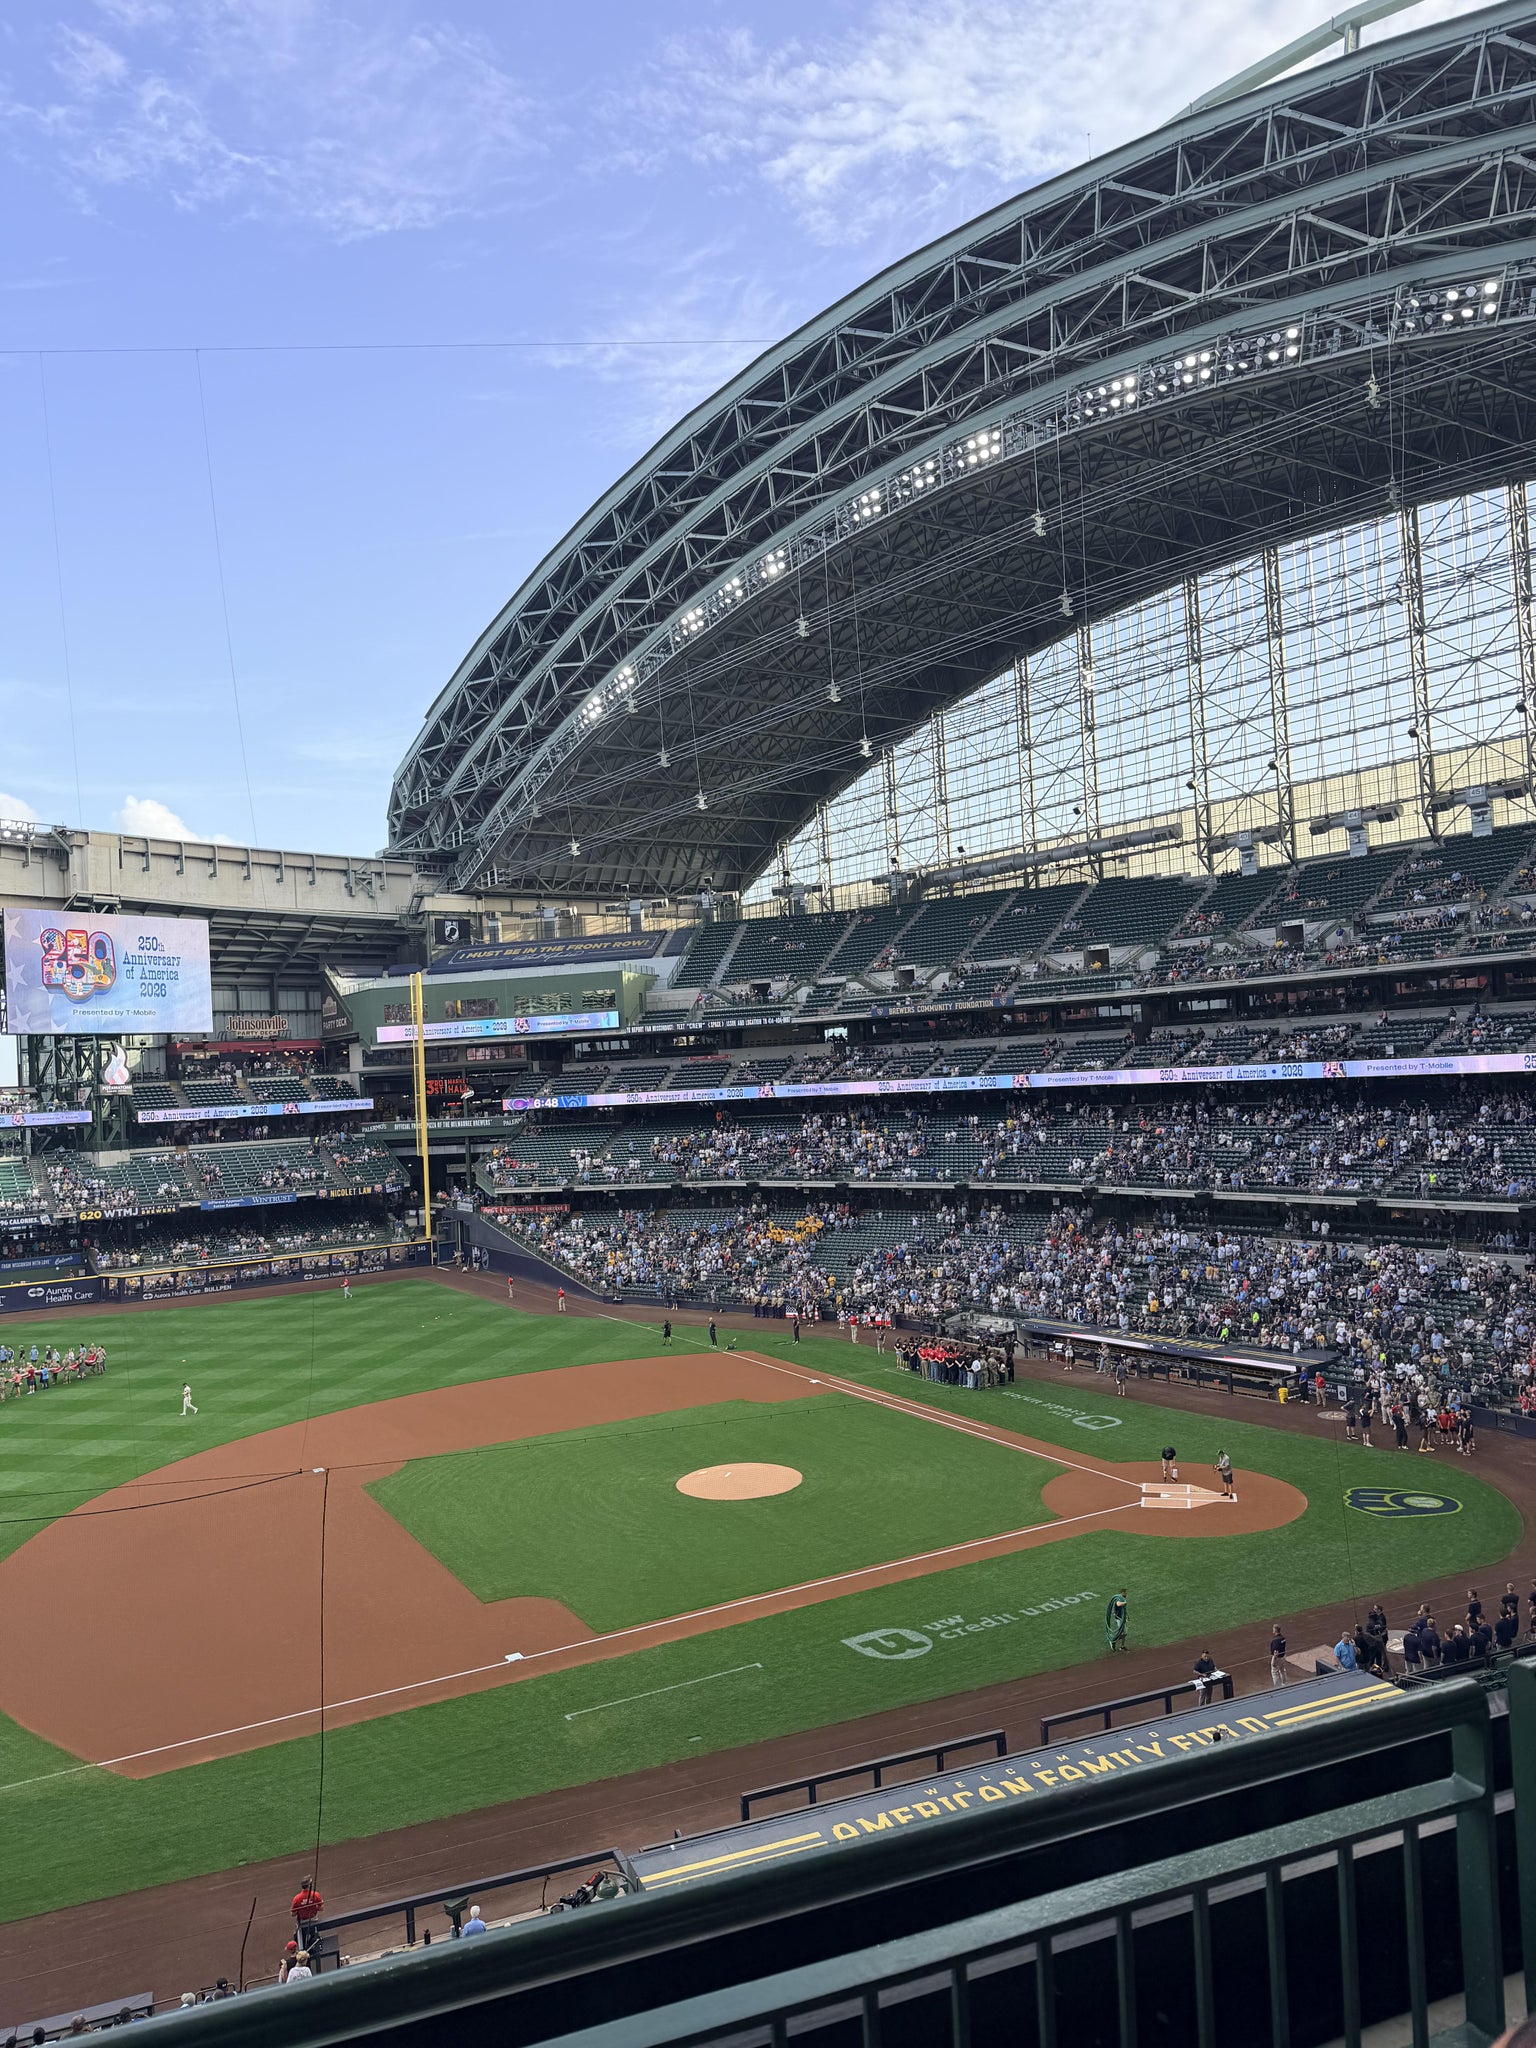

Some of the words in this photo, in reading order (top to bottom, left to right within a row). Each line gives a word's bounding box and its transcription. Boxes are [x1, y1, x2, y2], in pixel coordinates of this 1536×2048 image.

[138, 936, 165, 952] 250th
[466, 950, 502, 959] MUST
[503, 948, 521, 956] BE
[540, 945, 565, 953] THE
[566, 943, 611, 951] FRONT
[612, 939, 649, 948] ROW!
[123, 951, 181, 967] Anniversary
[126, 966, 135, 980] of
[140, 966, 179, 980] America
[140, 982, 167, 997] 2026
[114, 1009, 124, 1017] by
[888, 1006, 915, 1015] BREWERS
[917, 1003, 952, 1014] COMMUNITY
[955, 1000, 994, 1010] FOUNDATION
[226, 1014, 288, 1031] Johnsonville
[336, 1017, 348, 1028] DECK
[1181, 1069, 1223, 1081] Anniversary
[1226, 1068, 1233, 1079] of
[1237, 1067, 1267, 1079] America
[1281, 1065, 1303, 1077] 2026
[1367, 1064, 1407, 1072] Presented
[1408, 1063, 1418, 1072] by
[1419, 1062, 1454, 1070] T-Mobile
[942, 1080, 968, 1089] America
[979, 1077, 997, 1087] 2026
[726, 1088, 744, 1098] 2026
[533, 1098, 559, 1108] 6:48
[162, 1111, 201, 1120] Anniversary
[213, 1108, 239, 1118] America
[330, 1188, 356, 1198] NICOLET
[358, 1186, 372, 1195] LAW
[251, 1194, 293, 1204] WINTRUST
[79, 1210, 102, 1221] 620
[103, 1207, 139, 1218] WTMJ
[141, 1207, 176, 1215] BREWERS
[9, 1217, 40, 1225] CALORIES.
[359, 1265, 385, 1274] BULLPEN
[46, 1286, 73, 1295] Aurora
[204, 1284, 232, 1293] BULLPEN
[45, 1293, 72, 1304] Health
[74, 1291, 94, 1300] Care
[939, 1611, 1019, 1640] credit
[1018, 1590, 1100, 1617] union
[923, 1614, 966, 1631] uw
[923, 1747, 1095, 1796] WELCOME
[1125, 1731, 1160, 1745] TO
[832, 1776, 1035, 1842] AMERICAN
